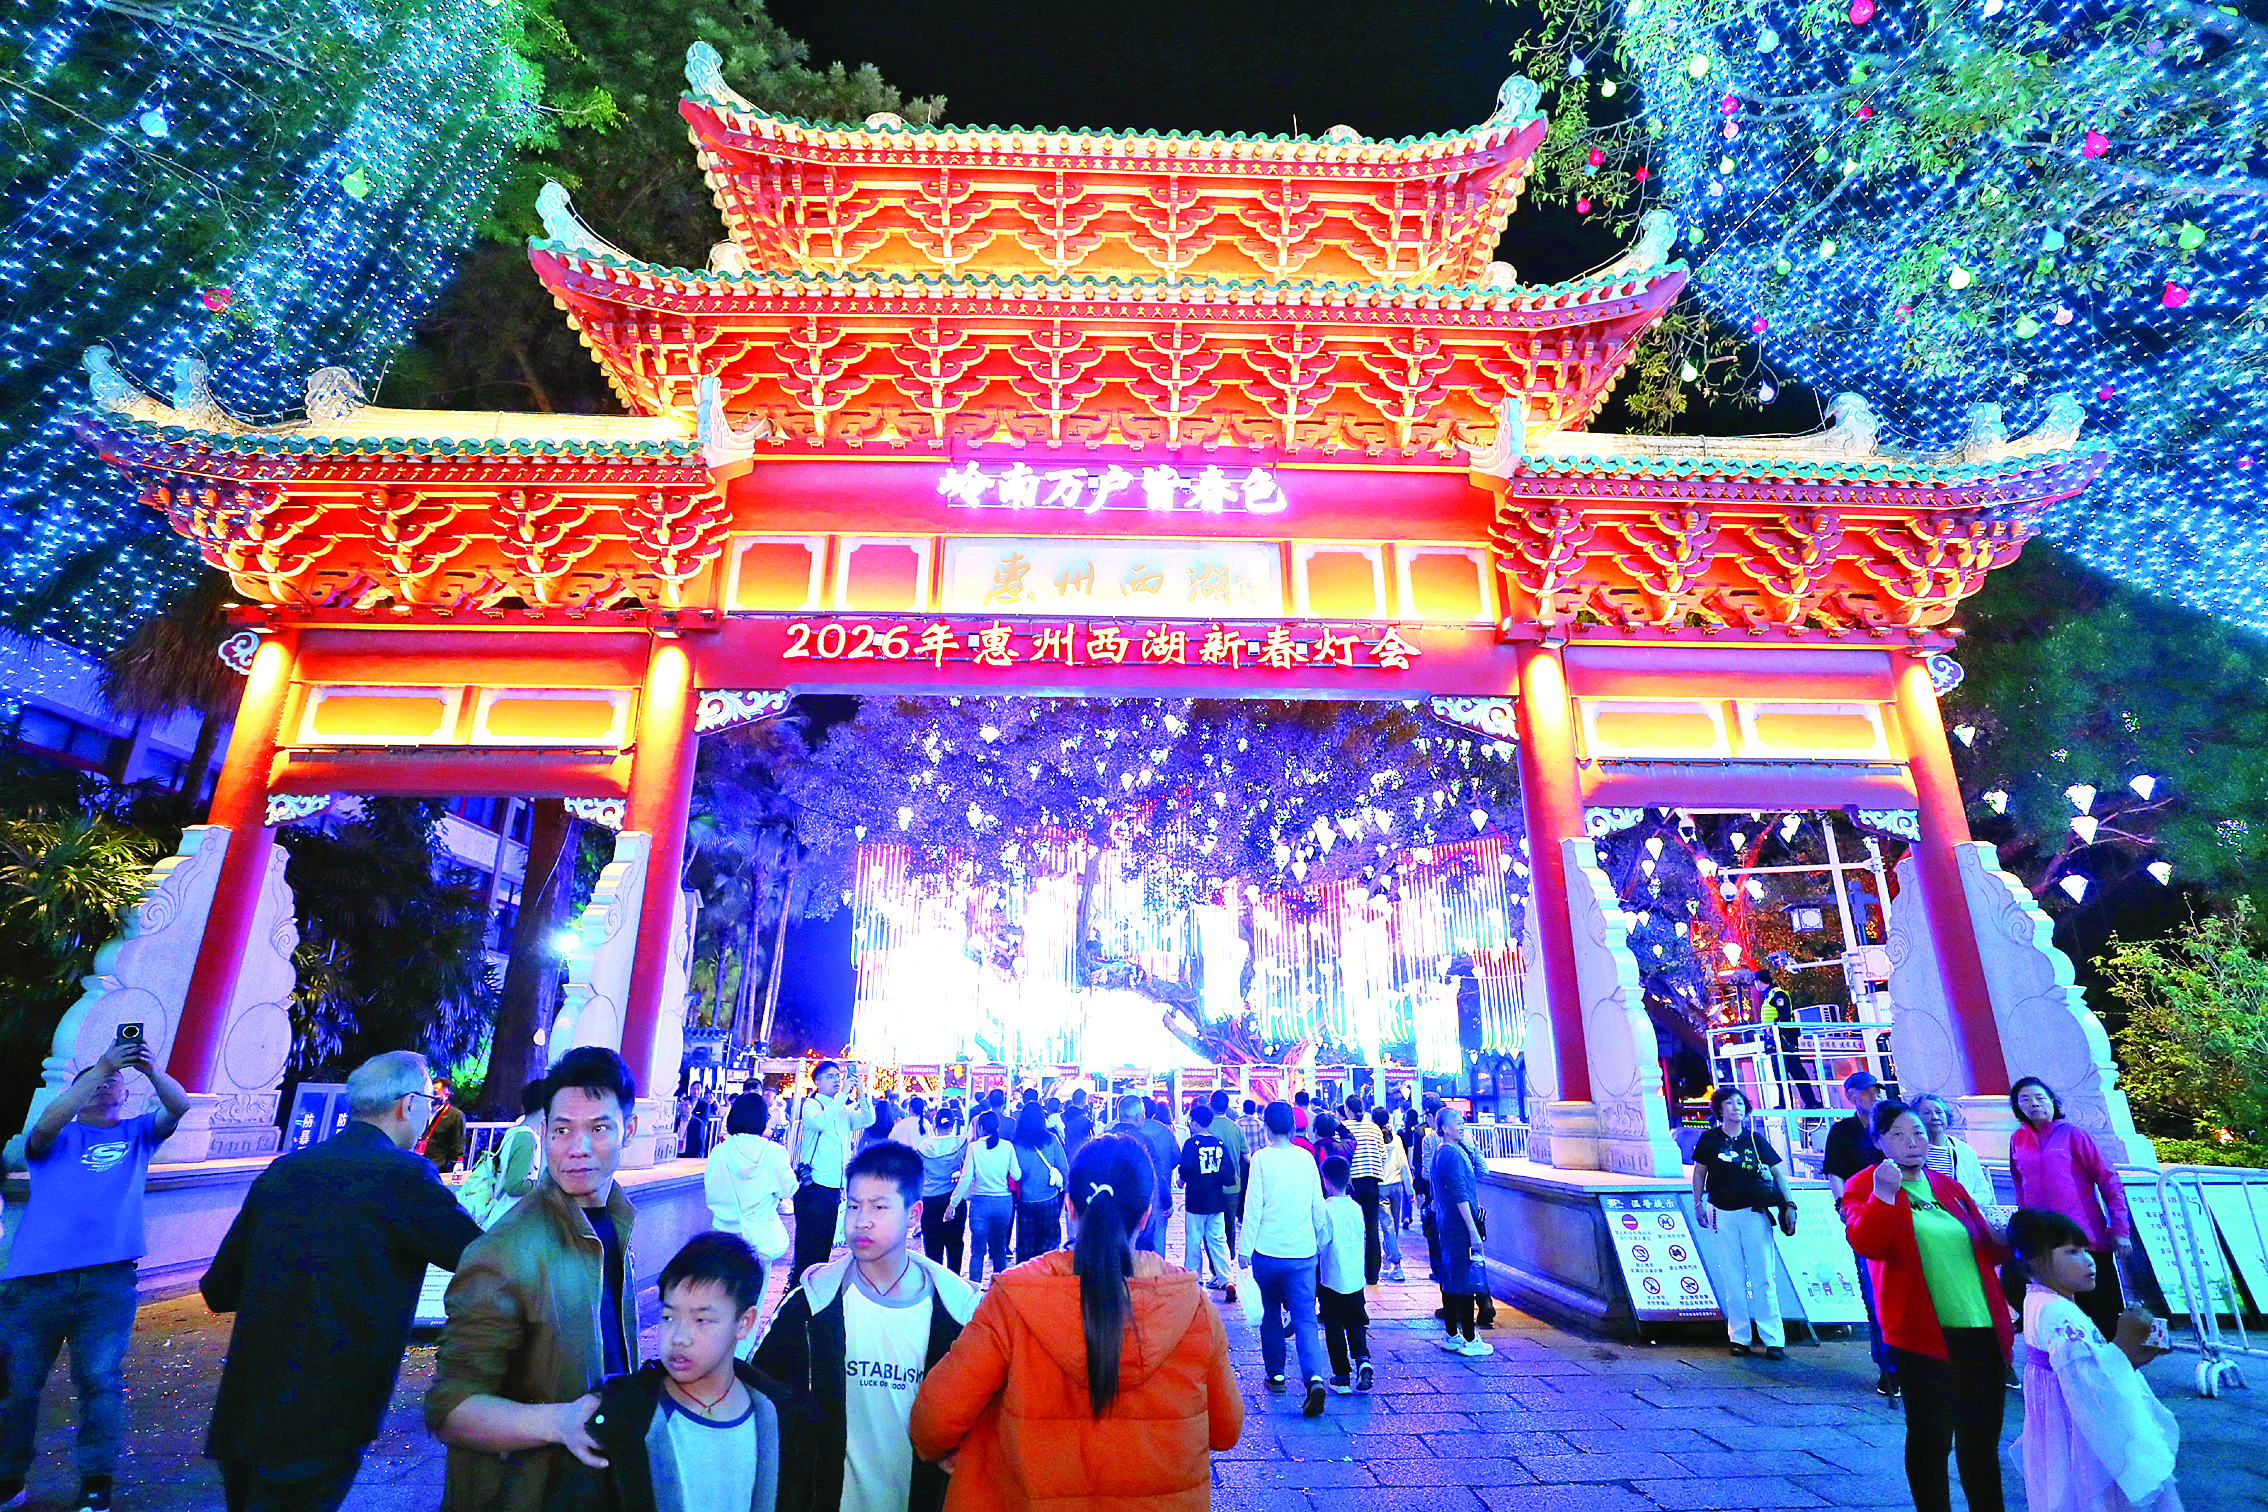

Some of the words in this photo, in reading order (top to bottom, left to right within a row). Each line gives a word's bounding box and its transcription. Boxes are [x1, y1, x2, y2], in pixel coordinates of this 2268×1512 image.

[937, 460, 1287, 515] 岭南万户皆春色
[983, 552, 1232, 606] 惠州西湖
[782, 620, 1424, 670] 2026年惠州西湖新春灯会
[297, 1113, 314, 1150] 防暴
[1631, 1199, 1675, 1209] 温馨提示
[859, 1379, 878, 1387] LUCK
[879, 1380, 889, 1388] OF
